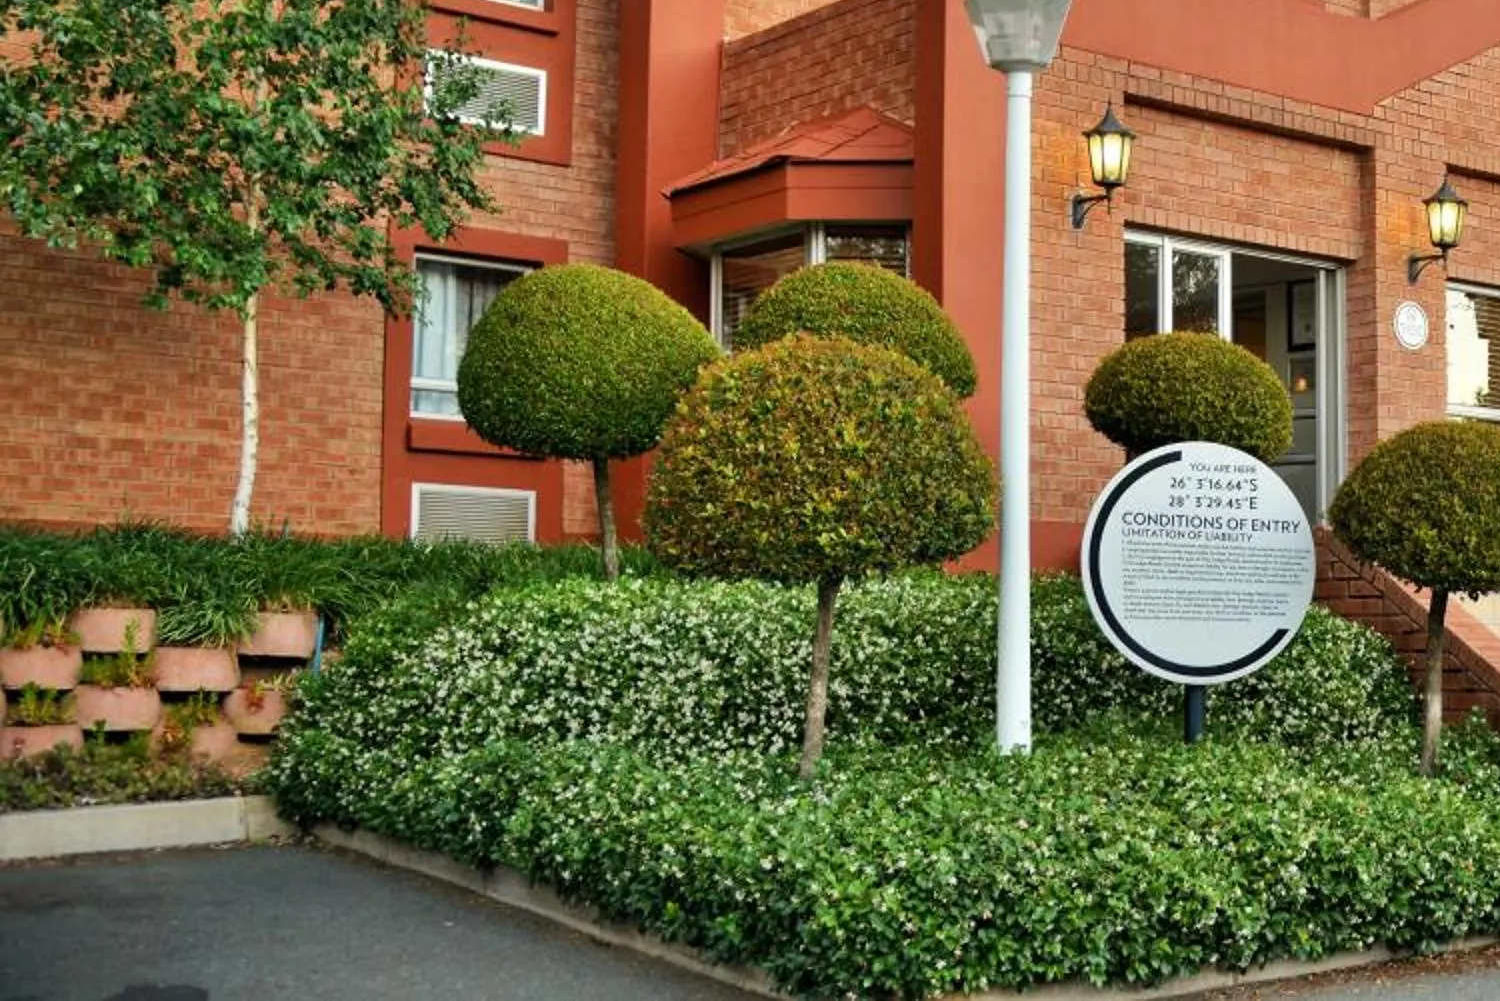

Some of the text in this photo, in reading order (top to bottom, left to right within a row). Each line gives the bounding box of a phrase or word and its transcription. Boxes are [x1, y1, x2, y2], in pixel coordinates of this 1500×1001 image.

[1122, 512, 1300, 534] CONDITIONS OF ENTRY
[1122, 527, 1253, 542] LIMITATION OF LIABILITY
